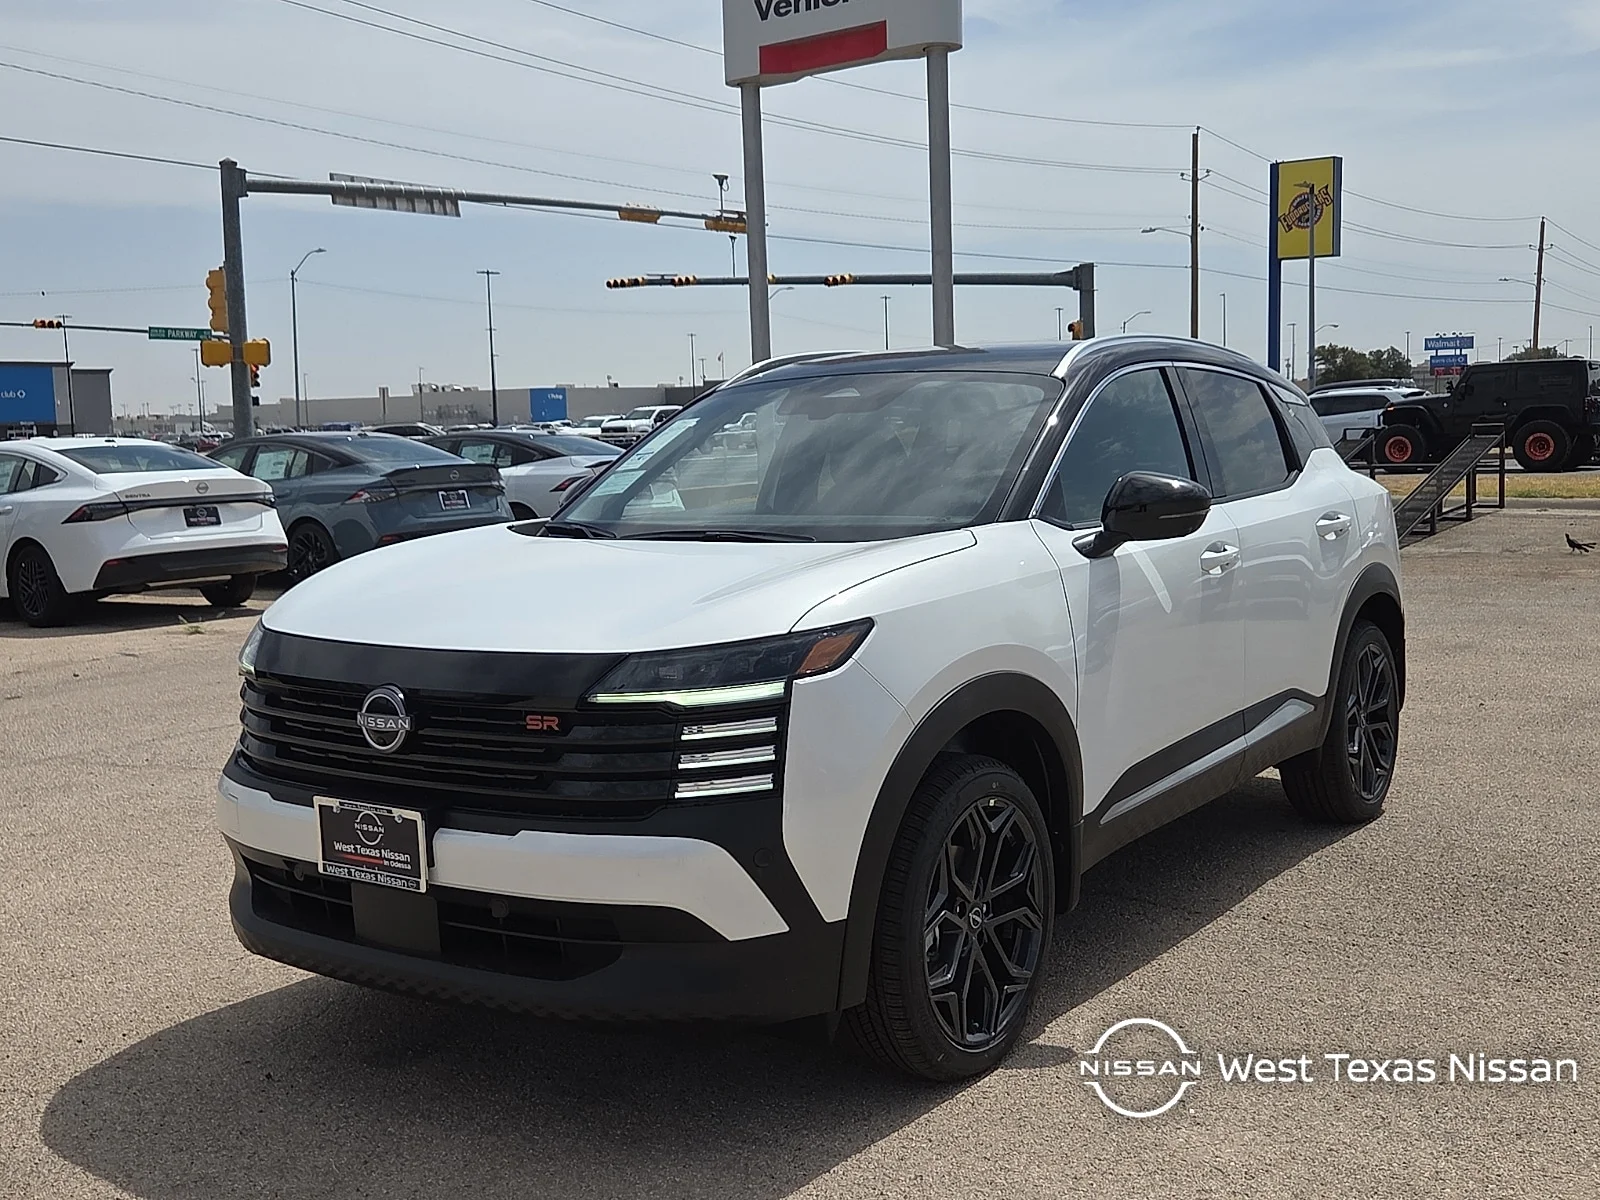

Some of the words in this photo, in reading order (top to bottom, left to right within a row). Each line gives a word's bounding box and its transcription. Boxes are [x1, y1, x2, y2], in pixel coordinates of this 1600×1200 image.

[167, 329, 198, 339] PARKWAY
[1427, 339, 1460, 348] Walmart
[357, 714, 410, 730] NISSAN
[525, 715, 560, 731] SR
[354, 823, 385, 833] NISSAN
[333, 841, 355, 853] West
[355, 844, 380, 857] Texas
[381, 849, 411, 862] Nissan
[326, 864, 348, 876] West
[350, 869, 376, 880] Texas
[377, 874, 408, 887] Nissan
